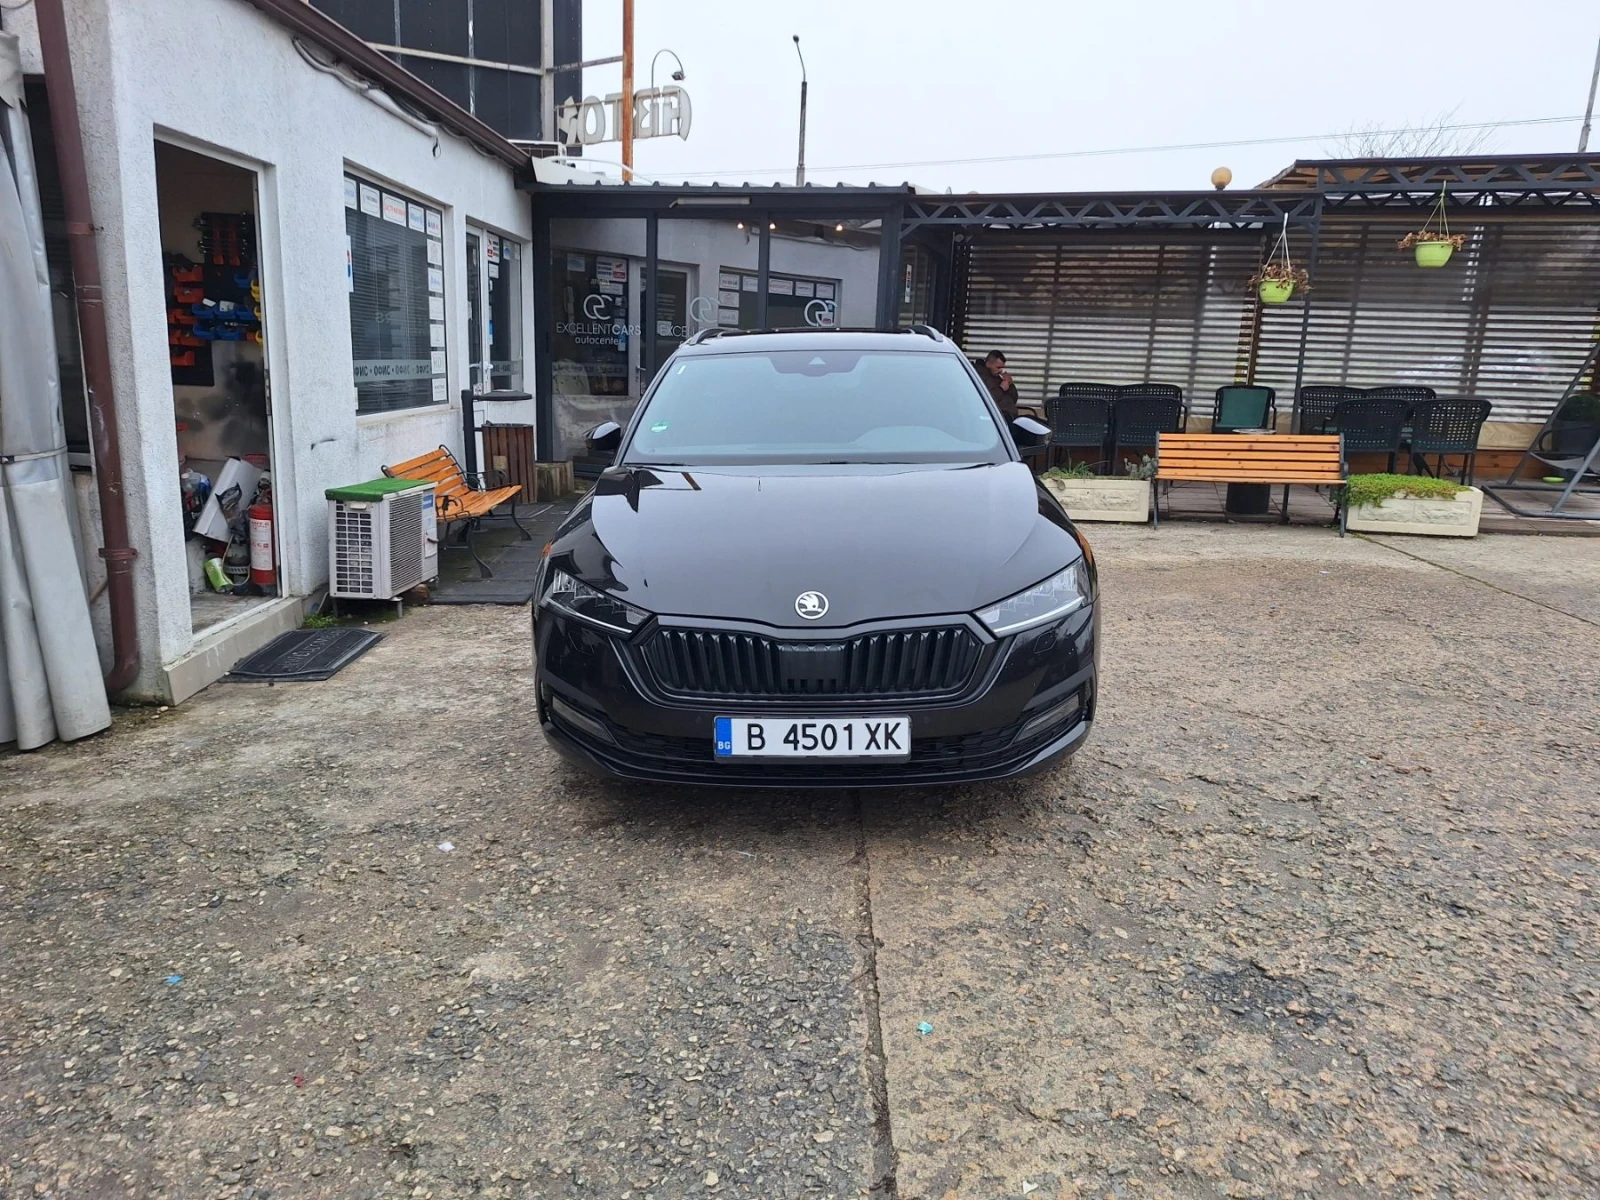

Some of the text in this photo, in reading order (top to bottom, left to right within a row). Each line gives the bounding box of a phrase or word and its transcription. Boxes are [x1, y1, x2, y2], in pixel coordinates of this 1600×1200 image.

[575, 336, 623, 346] autocenter
[783, 723, 853, 750] 4501
[718, 741, 730, 750] BG
